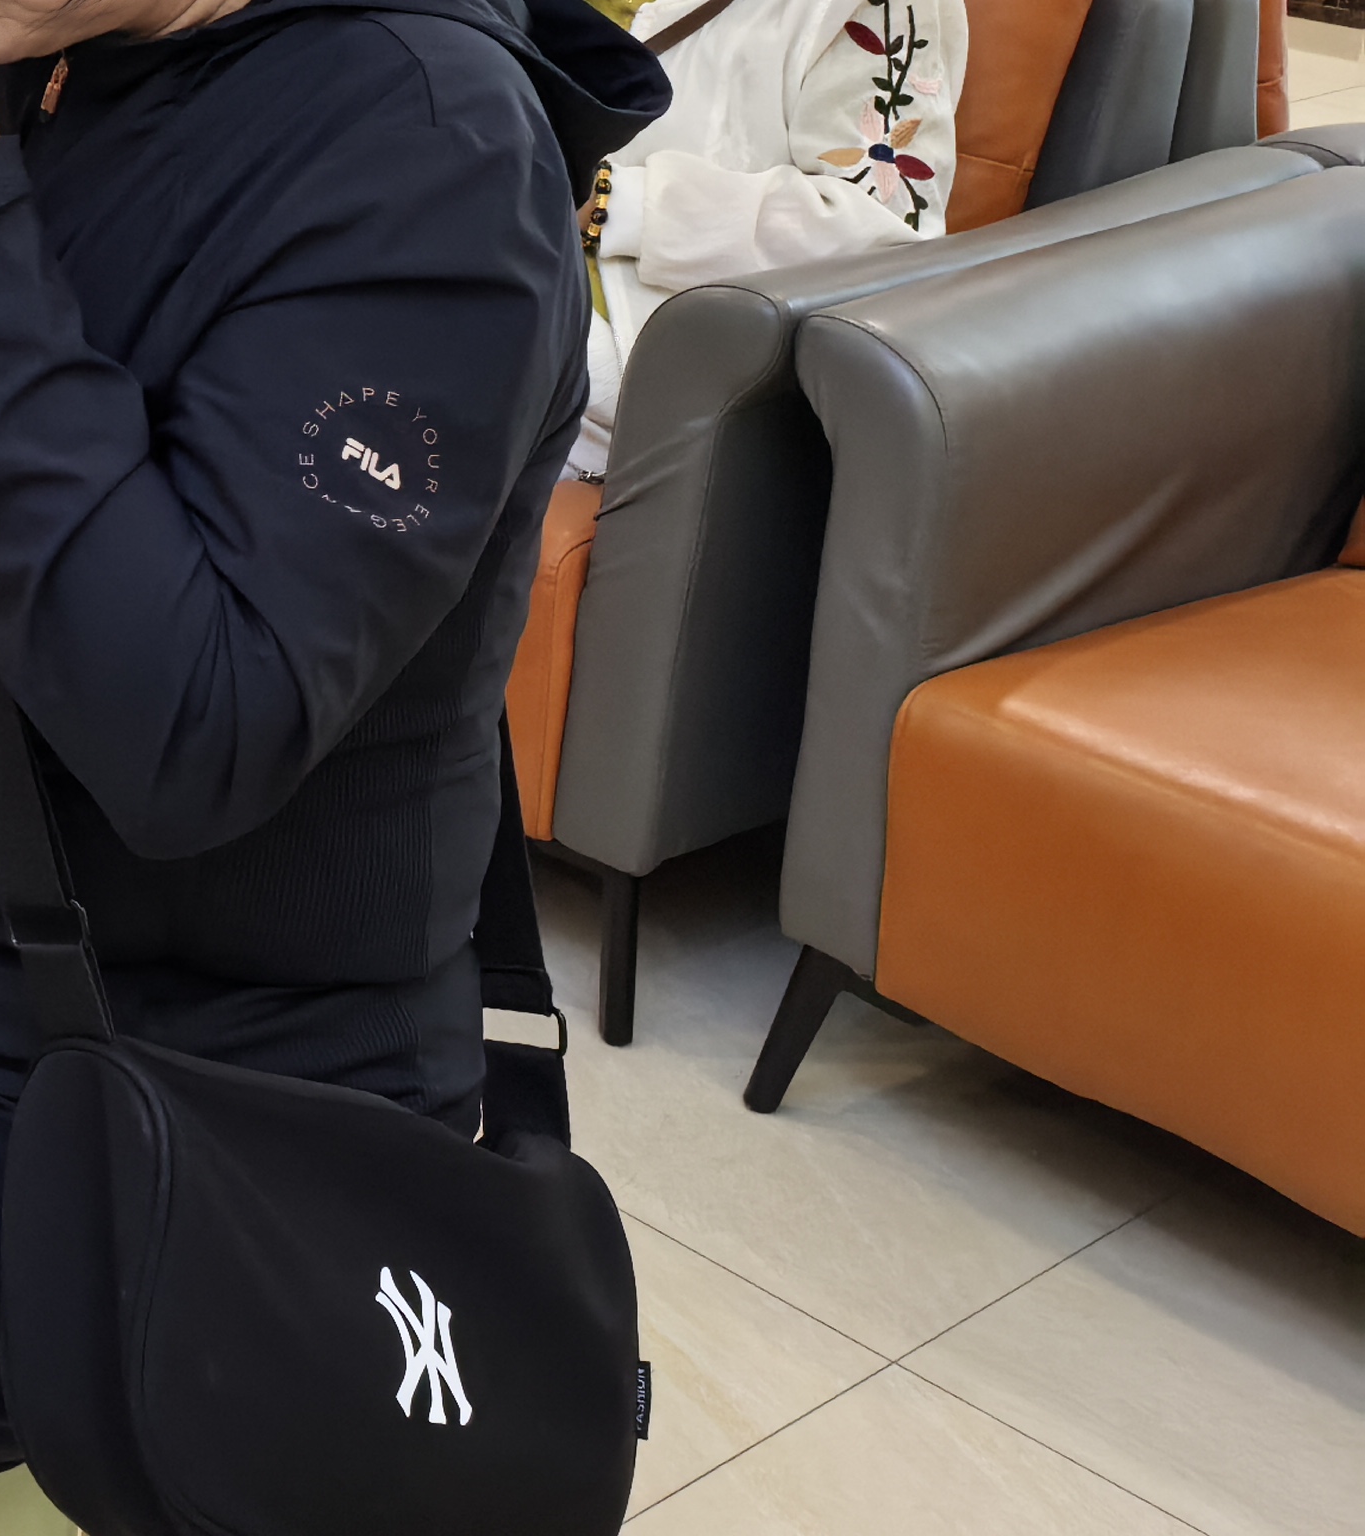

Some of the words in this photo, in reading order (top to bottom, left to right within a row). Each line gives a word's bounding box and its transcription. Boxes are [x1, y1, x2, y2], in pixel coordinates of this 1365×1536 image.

[302, 387, 401, 438] SHAPE
[411, 407, 441, 494] YOUR
[340, 437, 402, 491] FILA
